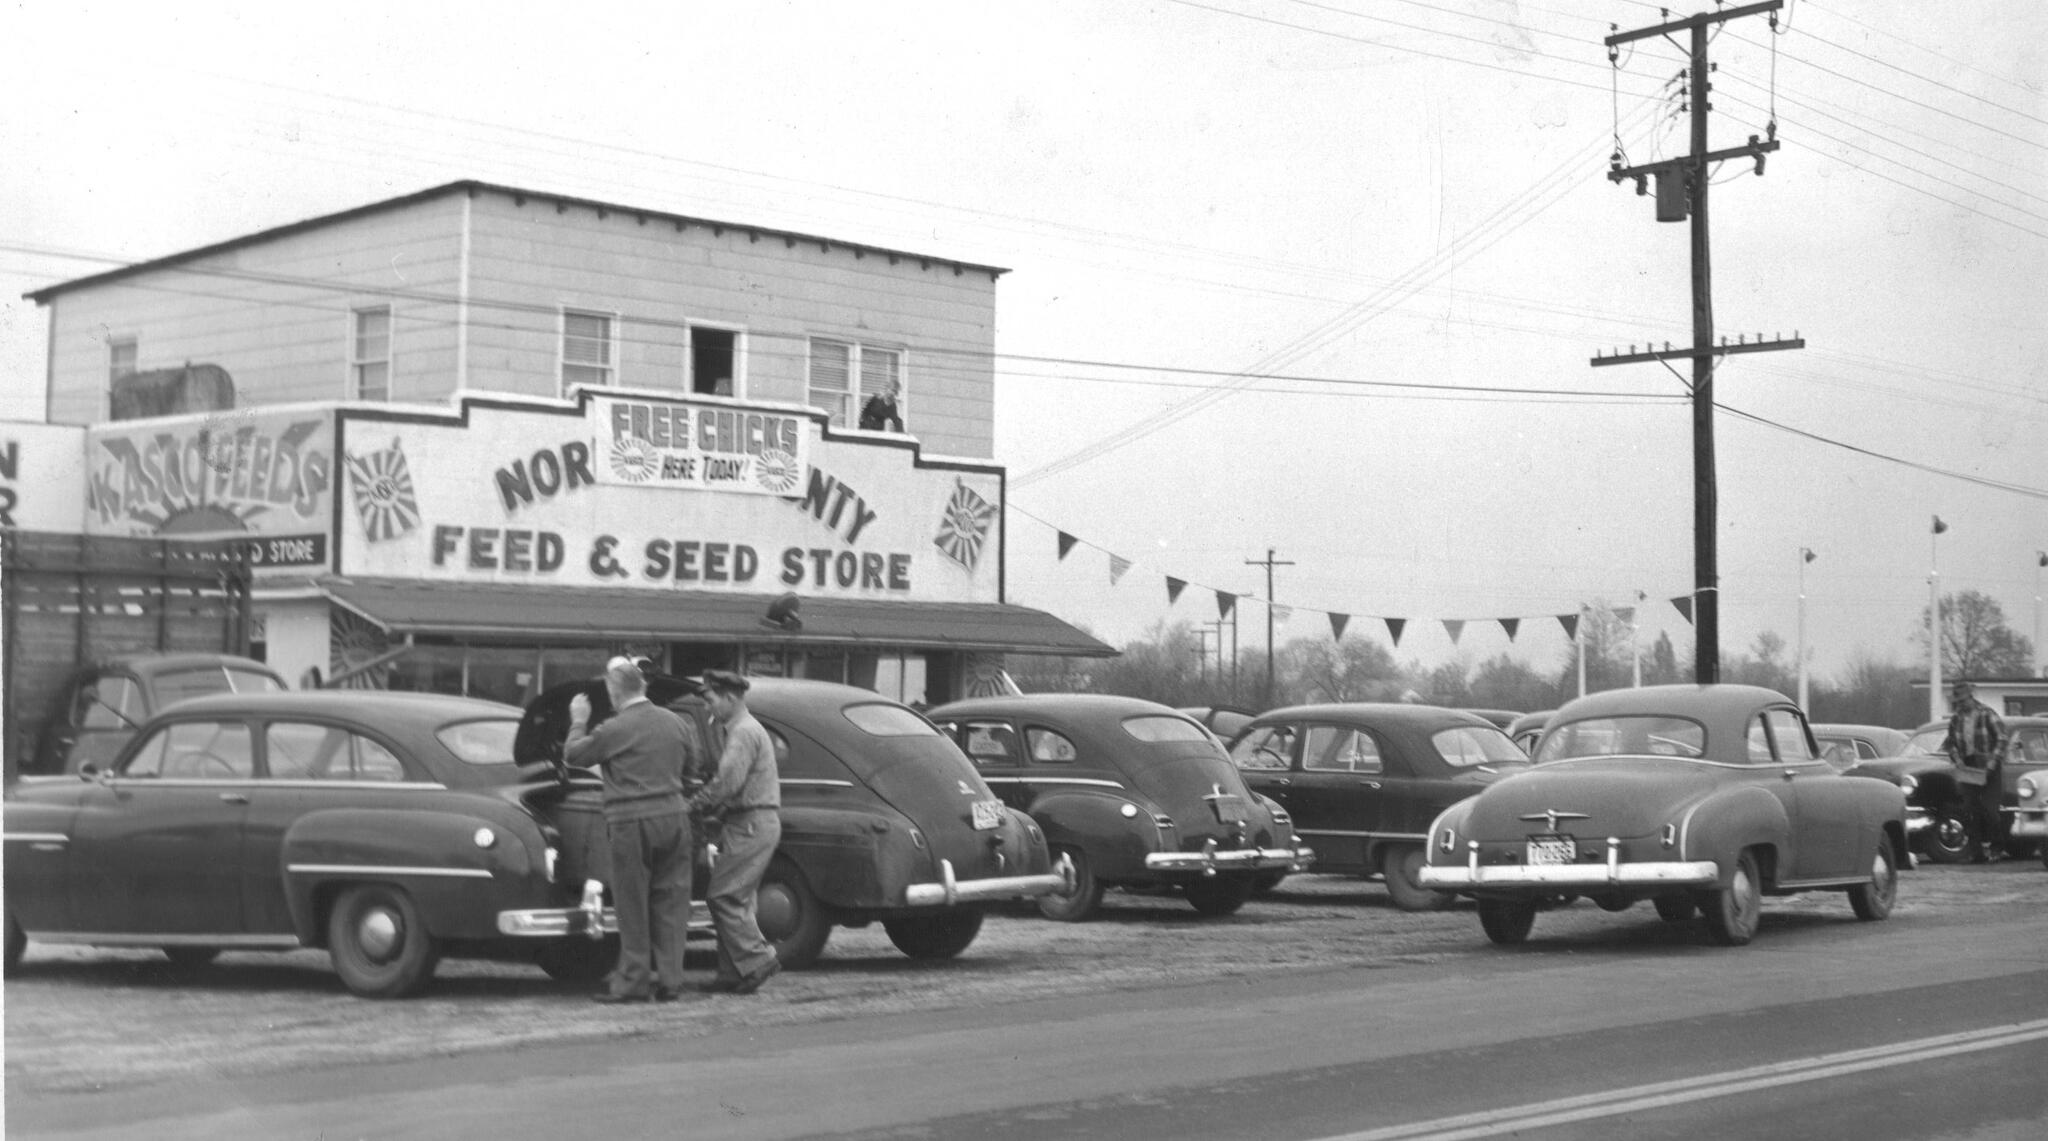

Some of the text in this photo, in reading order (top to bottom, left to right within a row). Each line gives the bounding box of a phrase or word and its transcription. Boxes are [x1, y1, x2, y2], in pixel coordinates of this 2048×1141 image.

[611, 403, 798, 457] FREE CHICKS
[89, 420, 329, 525] KASCO FEEDS
[661, 454, 747, 483] HERE TODAY!
[781, 465, 877, 545] NTY
[268, 539, 315, 563] STORE
[432, 524, 912, 591] FEED & SEED STORE
